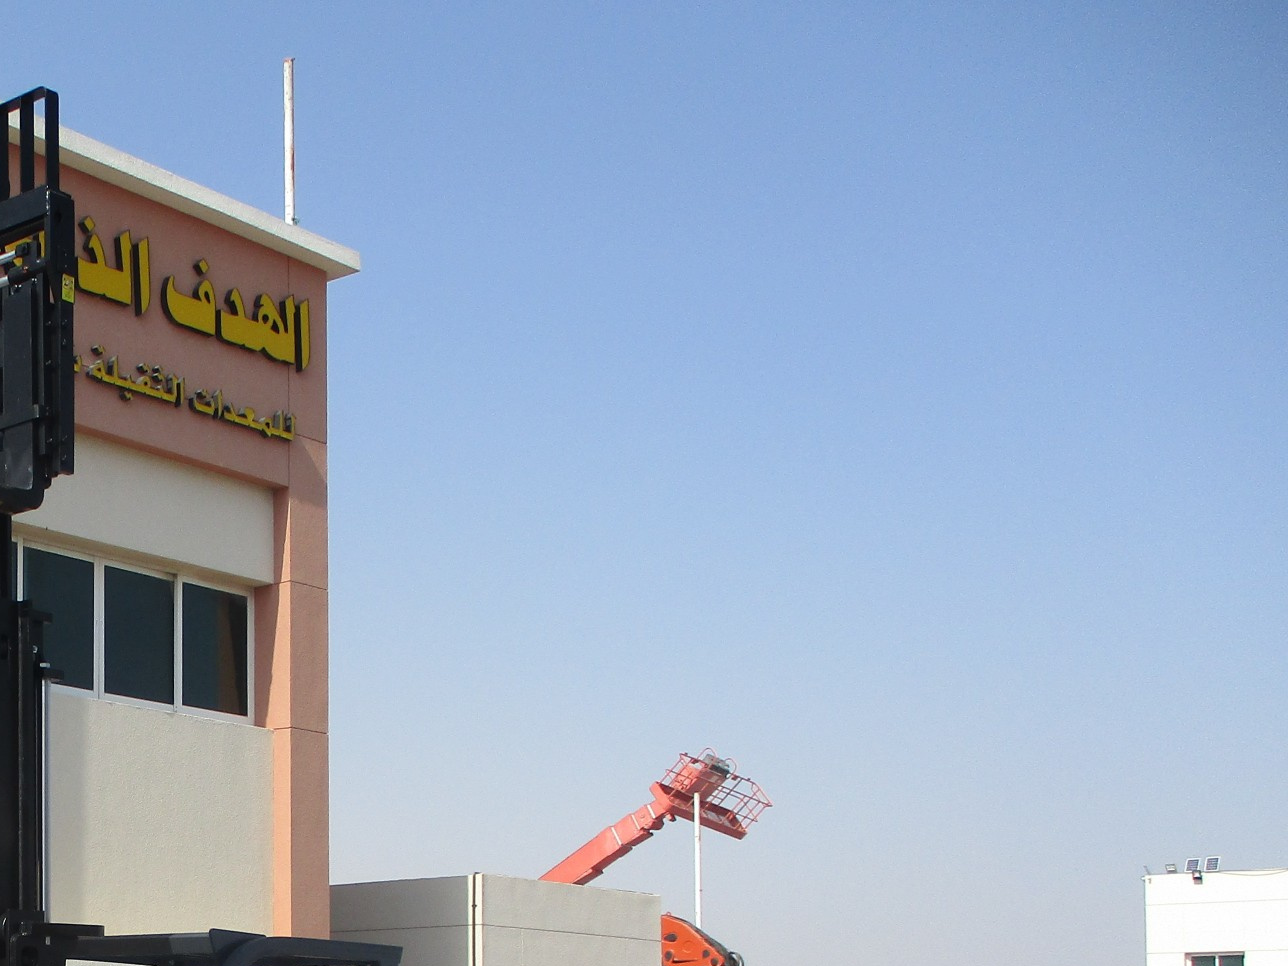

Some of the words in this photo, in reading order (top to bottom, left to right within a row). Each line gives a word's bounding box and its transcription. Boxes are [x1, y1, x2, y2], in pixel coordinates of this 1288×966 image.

[162, 257, 311, 373] الهدف
[86, 344, 186, 408] الثقيلة
[188, 388, 296, 441] للمعدات
